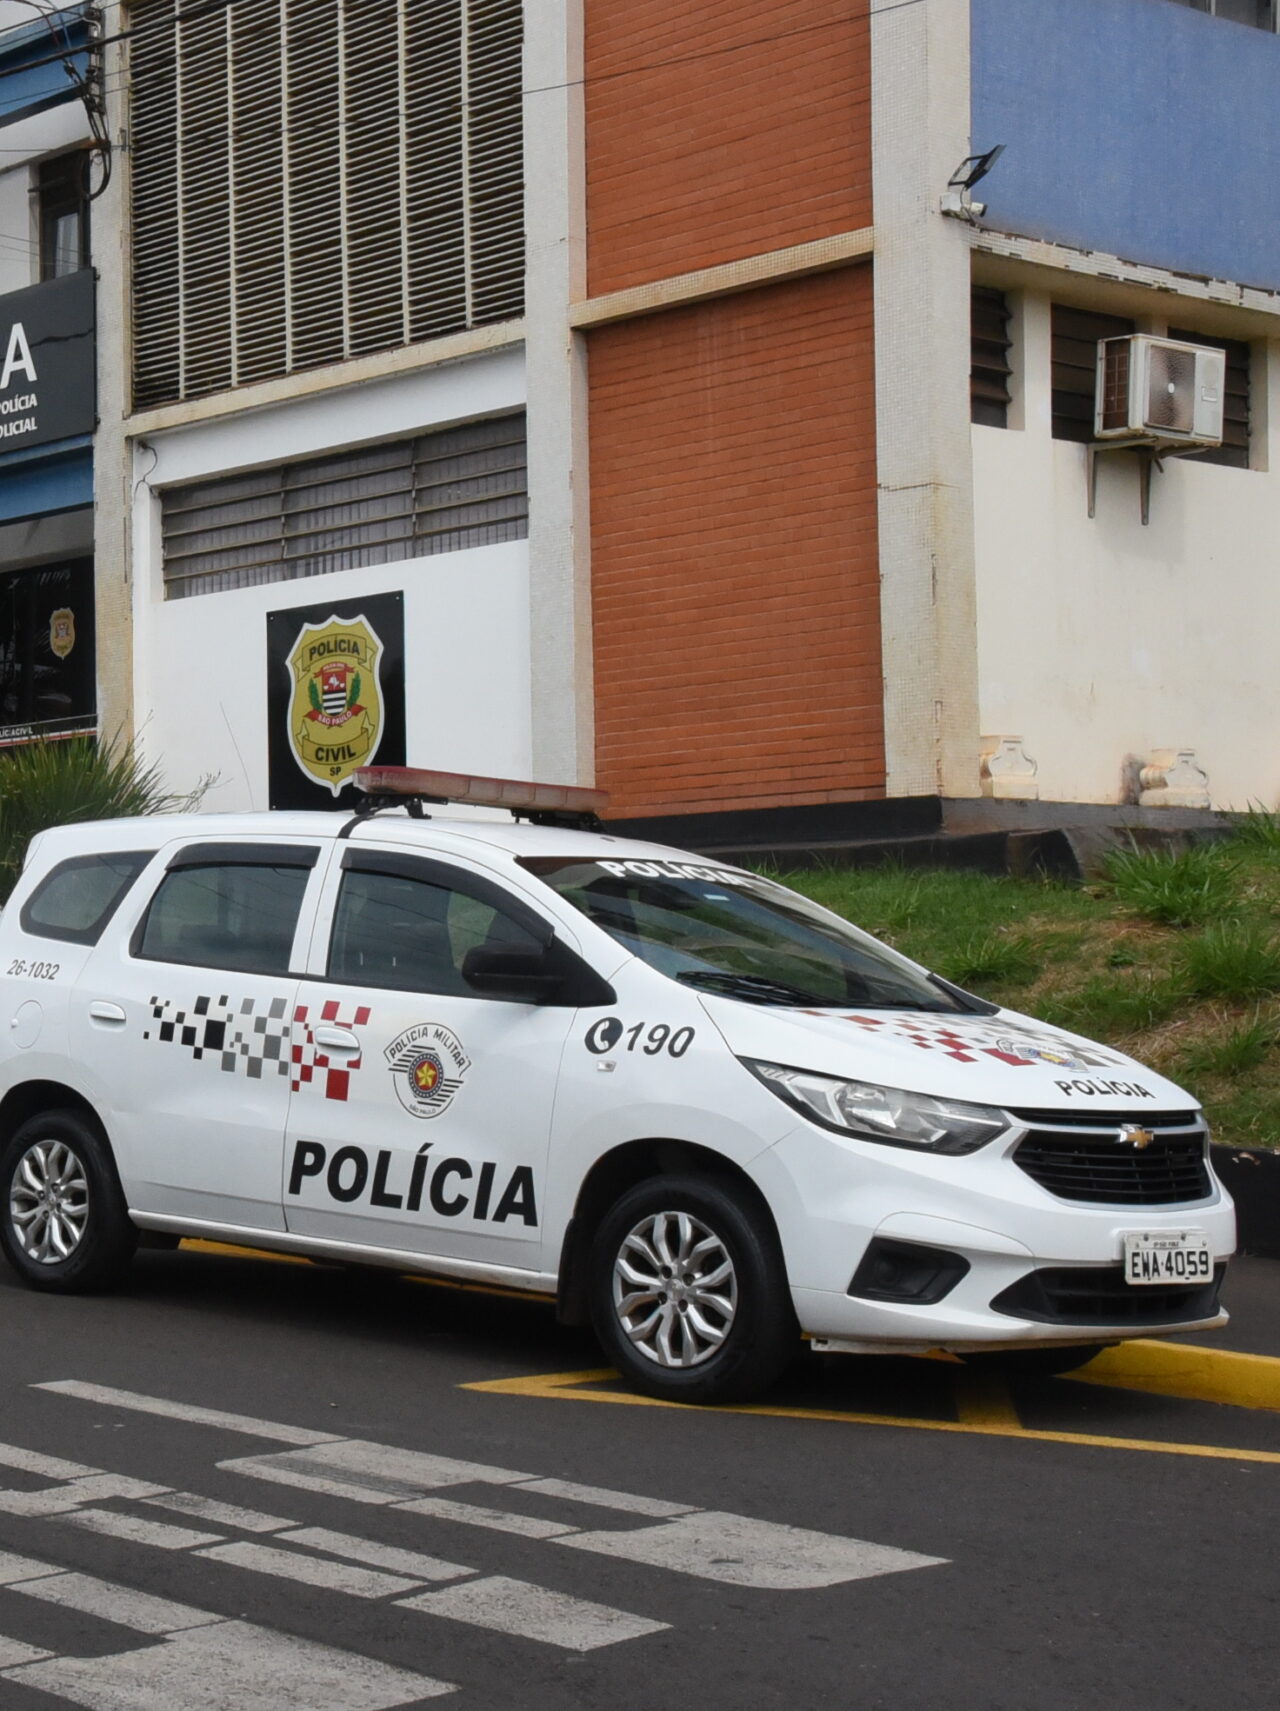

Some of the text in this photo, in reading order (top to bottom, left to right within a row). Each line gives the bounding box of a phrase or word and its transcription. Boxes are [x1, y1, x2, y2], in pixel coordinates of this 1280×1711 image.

[308, 635, 361, 661] POLÍCIA
[314, 744, 357, 762] CIVIL
[329, 766, 342, 777] SP
[595, 860, 754, 888] POLÍCIA
[6, 959, 60, 980] 26-1032
[388, 1026, 467, 1069] POLÍCIA MILITAR
[626, 1021, 696, 1059] 190
[1053, 1076, 1157, 1099] POLÍCIA
[288, 1142, 538, 1227] POLÍCIA
